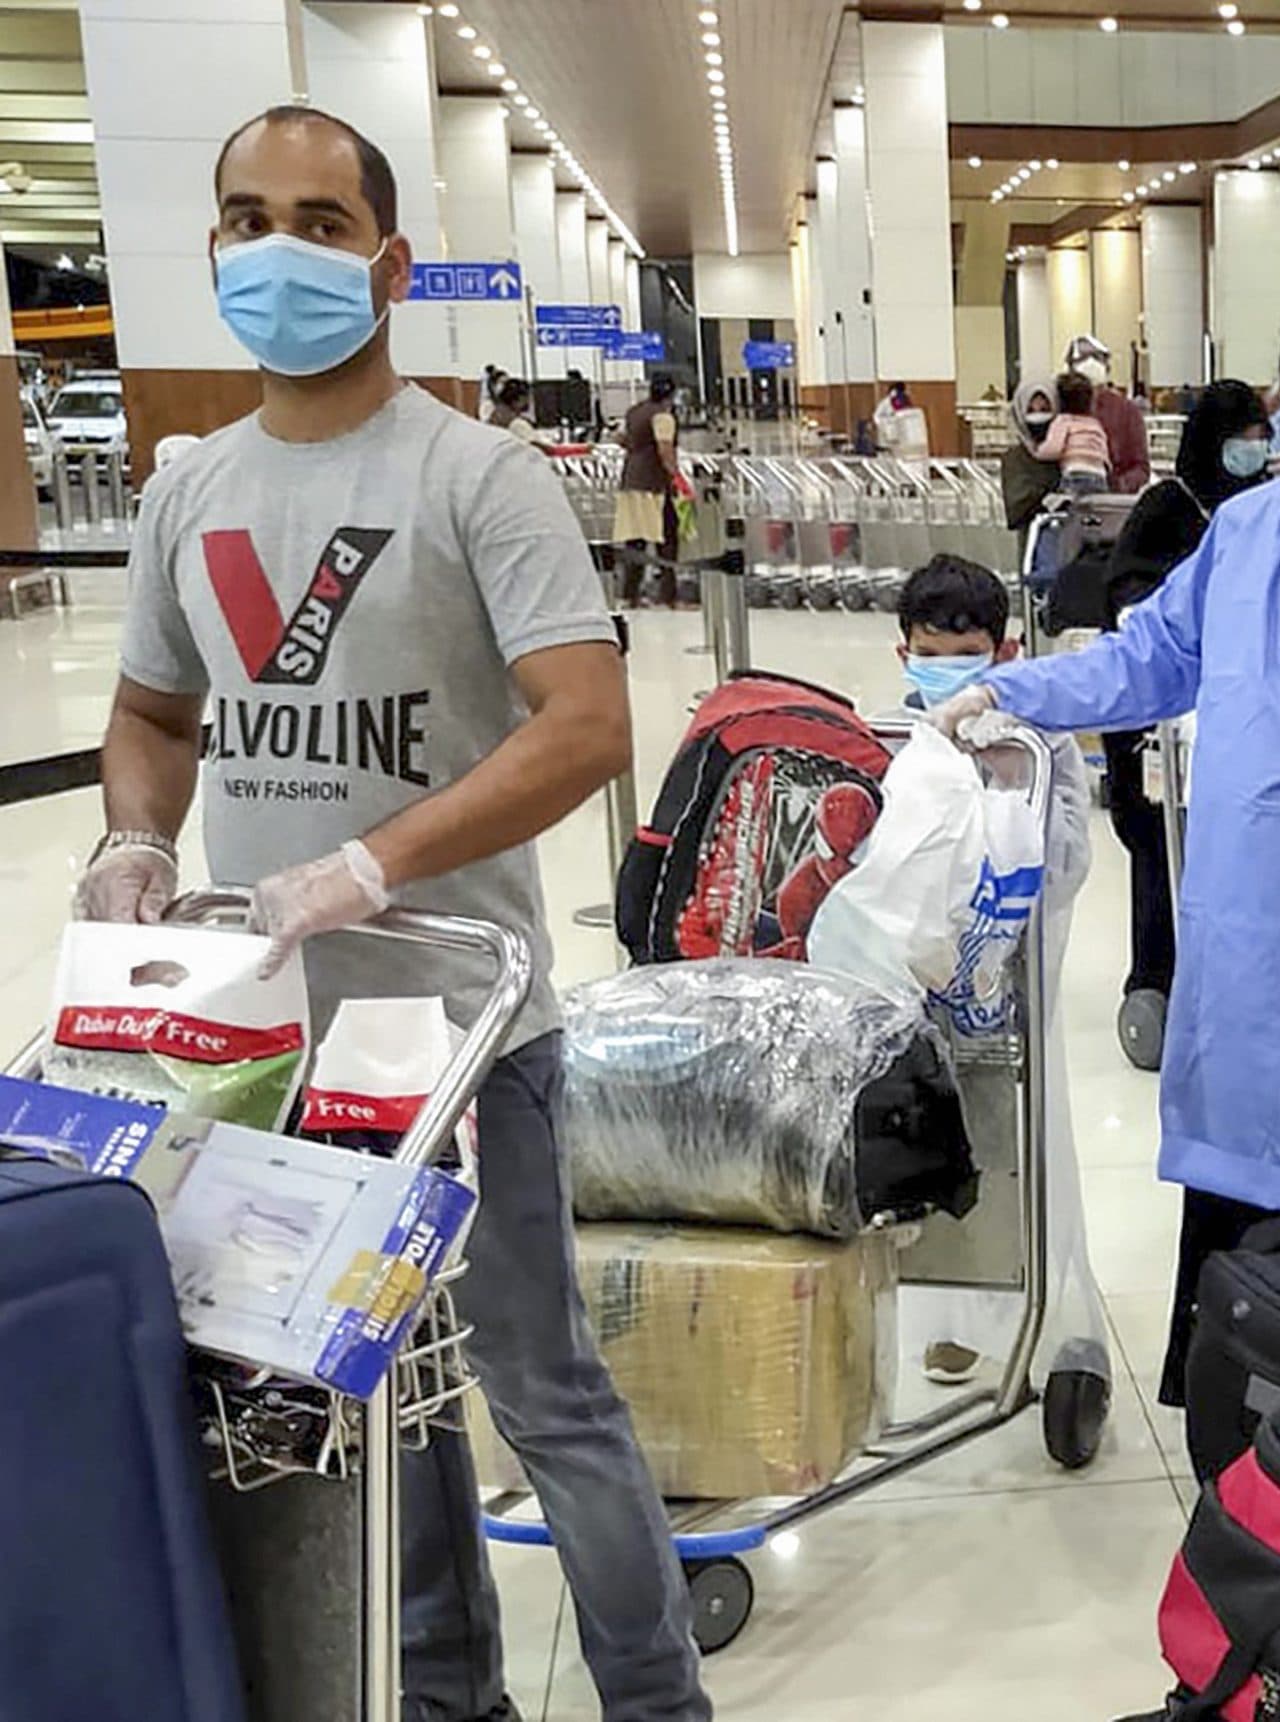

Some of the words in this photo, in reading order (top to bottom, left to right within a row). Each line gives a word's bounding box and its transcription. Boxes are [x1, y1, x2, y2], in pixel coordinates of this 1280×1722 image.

[276, 537, 364, 679] PARIS
[197, 689, 430, 788] LVOLINE
[224, 777, 261, 799] NEW
[264, 778, 349, 801] FASHION
[166, 1020, 228, 1052] Free
[318, 1098, 376, 1121] Free
[402, 1221, 438, 1269] POLE
